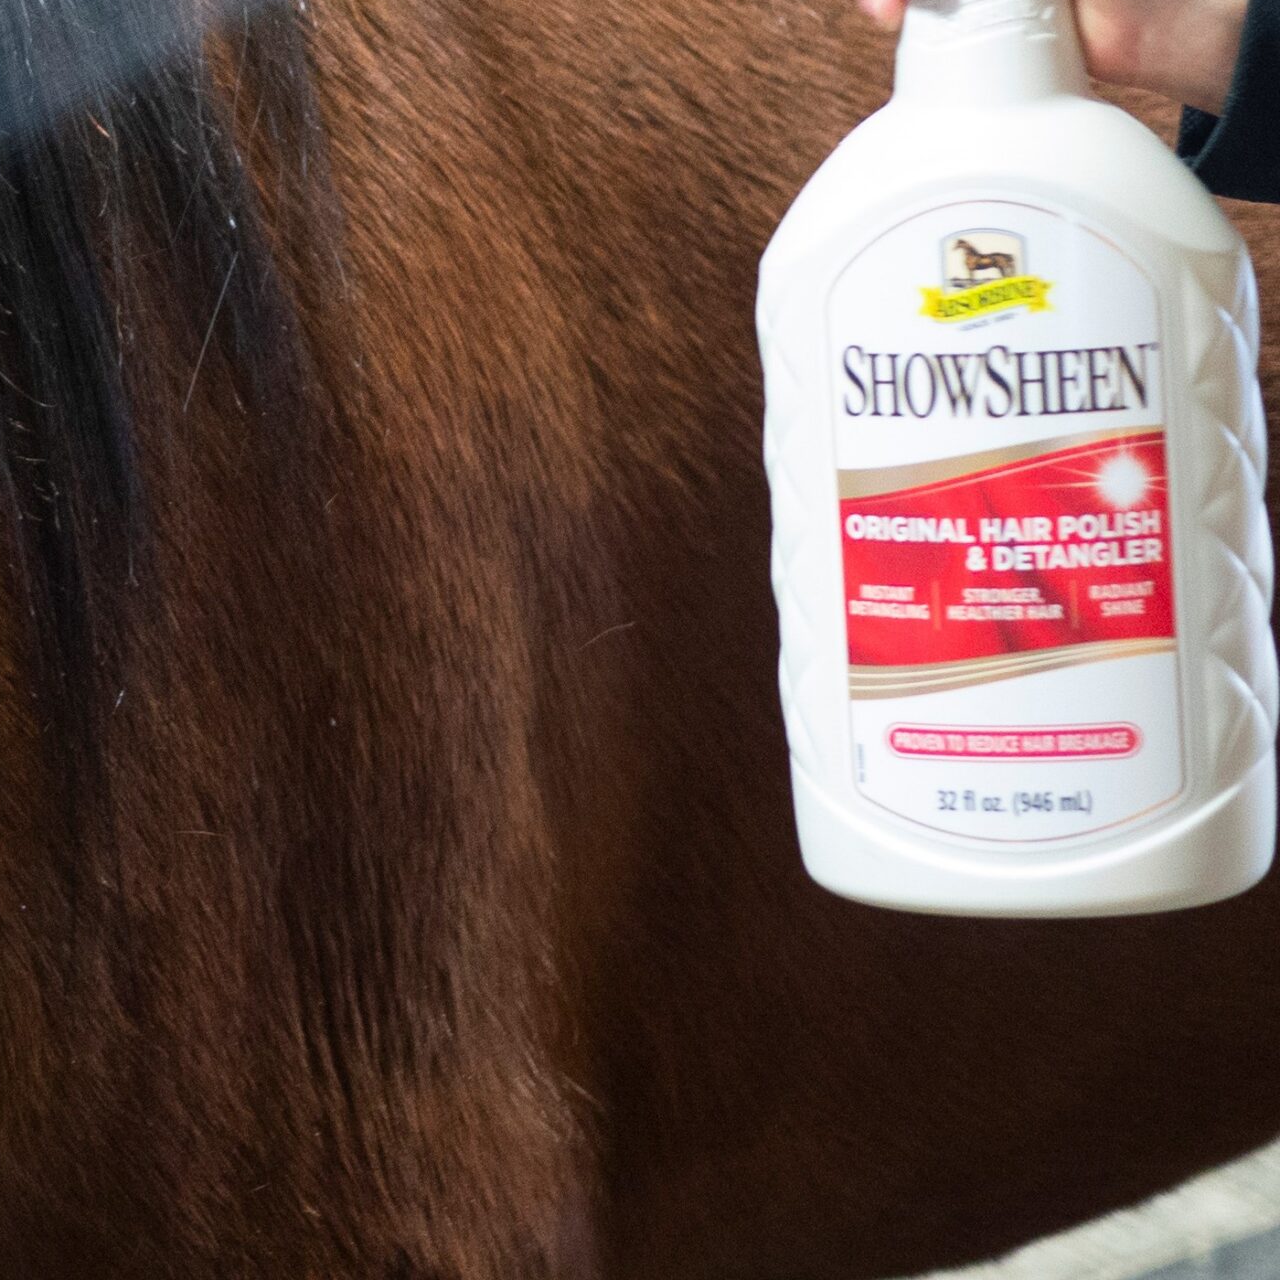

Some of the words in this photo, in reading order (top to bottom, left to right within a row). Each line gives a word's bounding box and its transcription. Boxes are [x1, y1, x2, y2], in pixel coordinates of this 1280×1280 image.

[845, 514, 975, 542] ORIGINAL
[979, 516, 1052, 543] HAIR
[1058, 510, 1161, 540] POLISH
[965, 546, 987, 571] &
[992, 538, 1163, 571] DETANGLER
[937, 790, 958, 811] 32
[1013, 792, 1053, 816] (946
